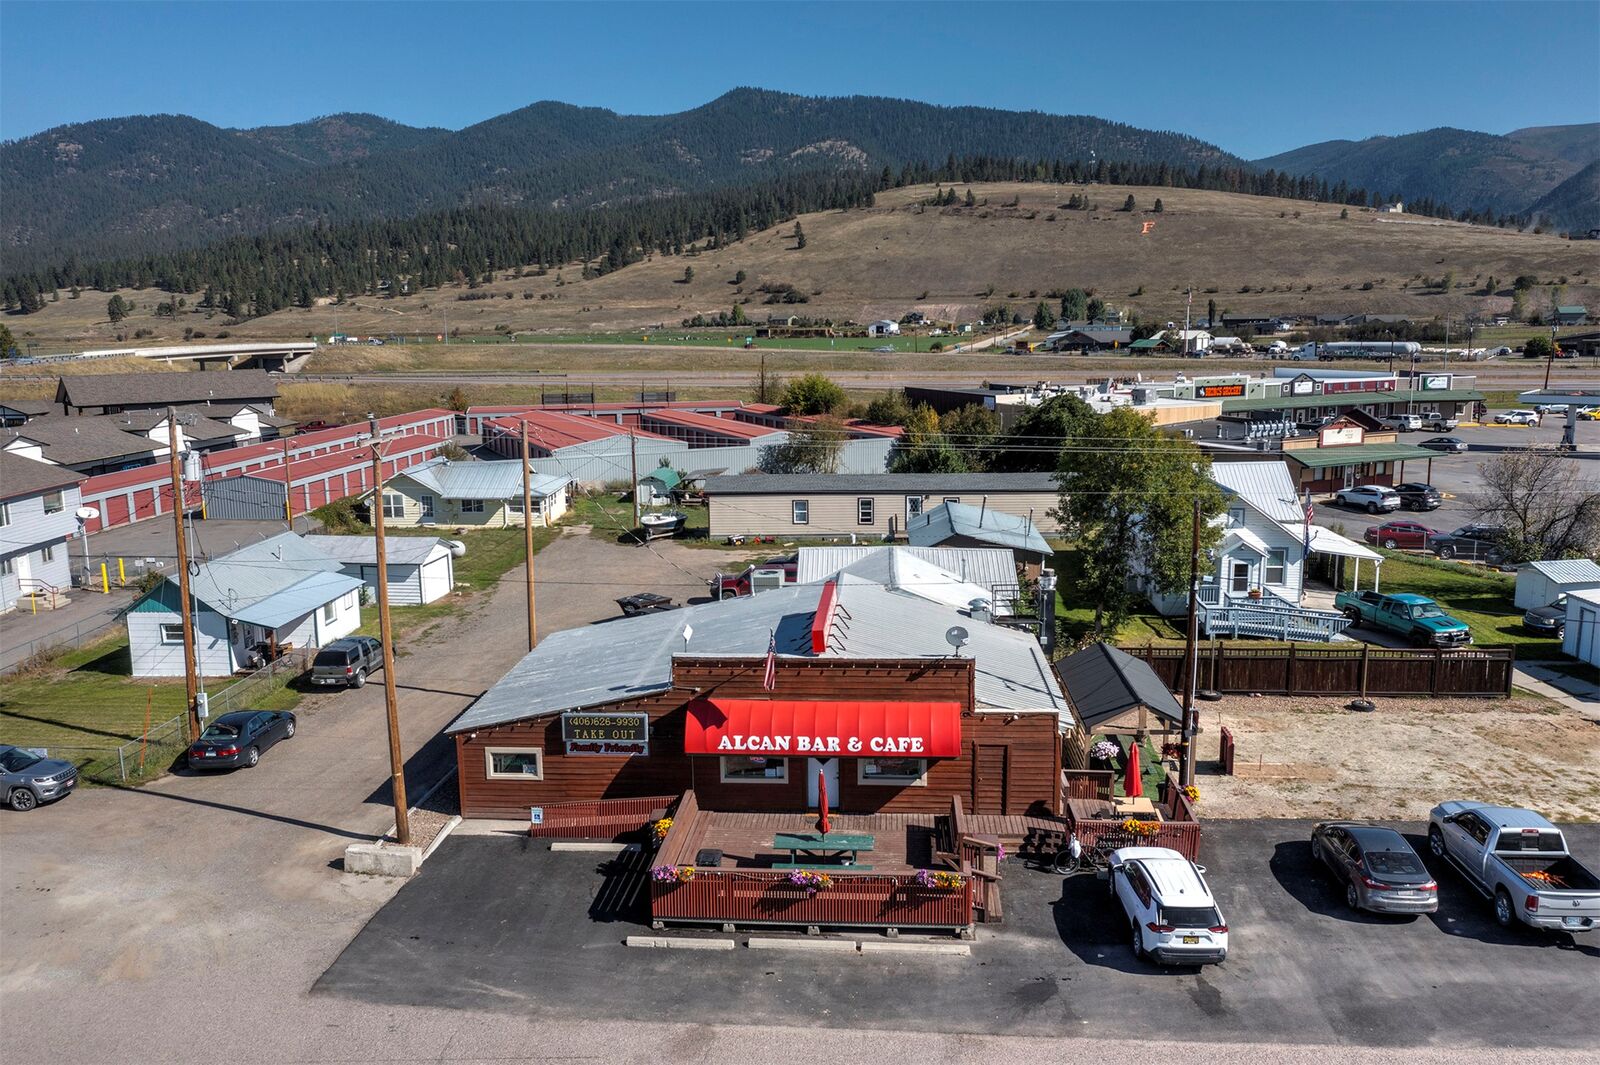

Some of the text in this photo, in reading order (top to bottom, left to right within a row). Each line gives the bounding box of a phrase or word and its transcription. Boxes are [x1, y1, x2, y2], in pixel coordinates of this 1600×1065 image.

[569, 717, 640, 727] (406)626-9930
[574, 729, 636, 739] TAKE OUT
[570, 742, 645, 754] Family Friendly
[717, 735, 925, 753] ALCAN BAR & CAFE
